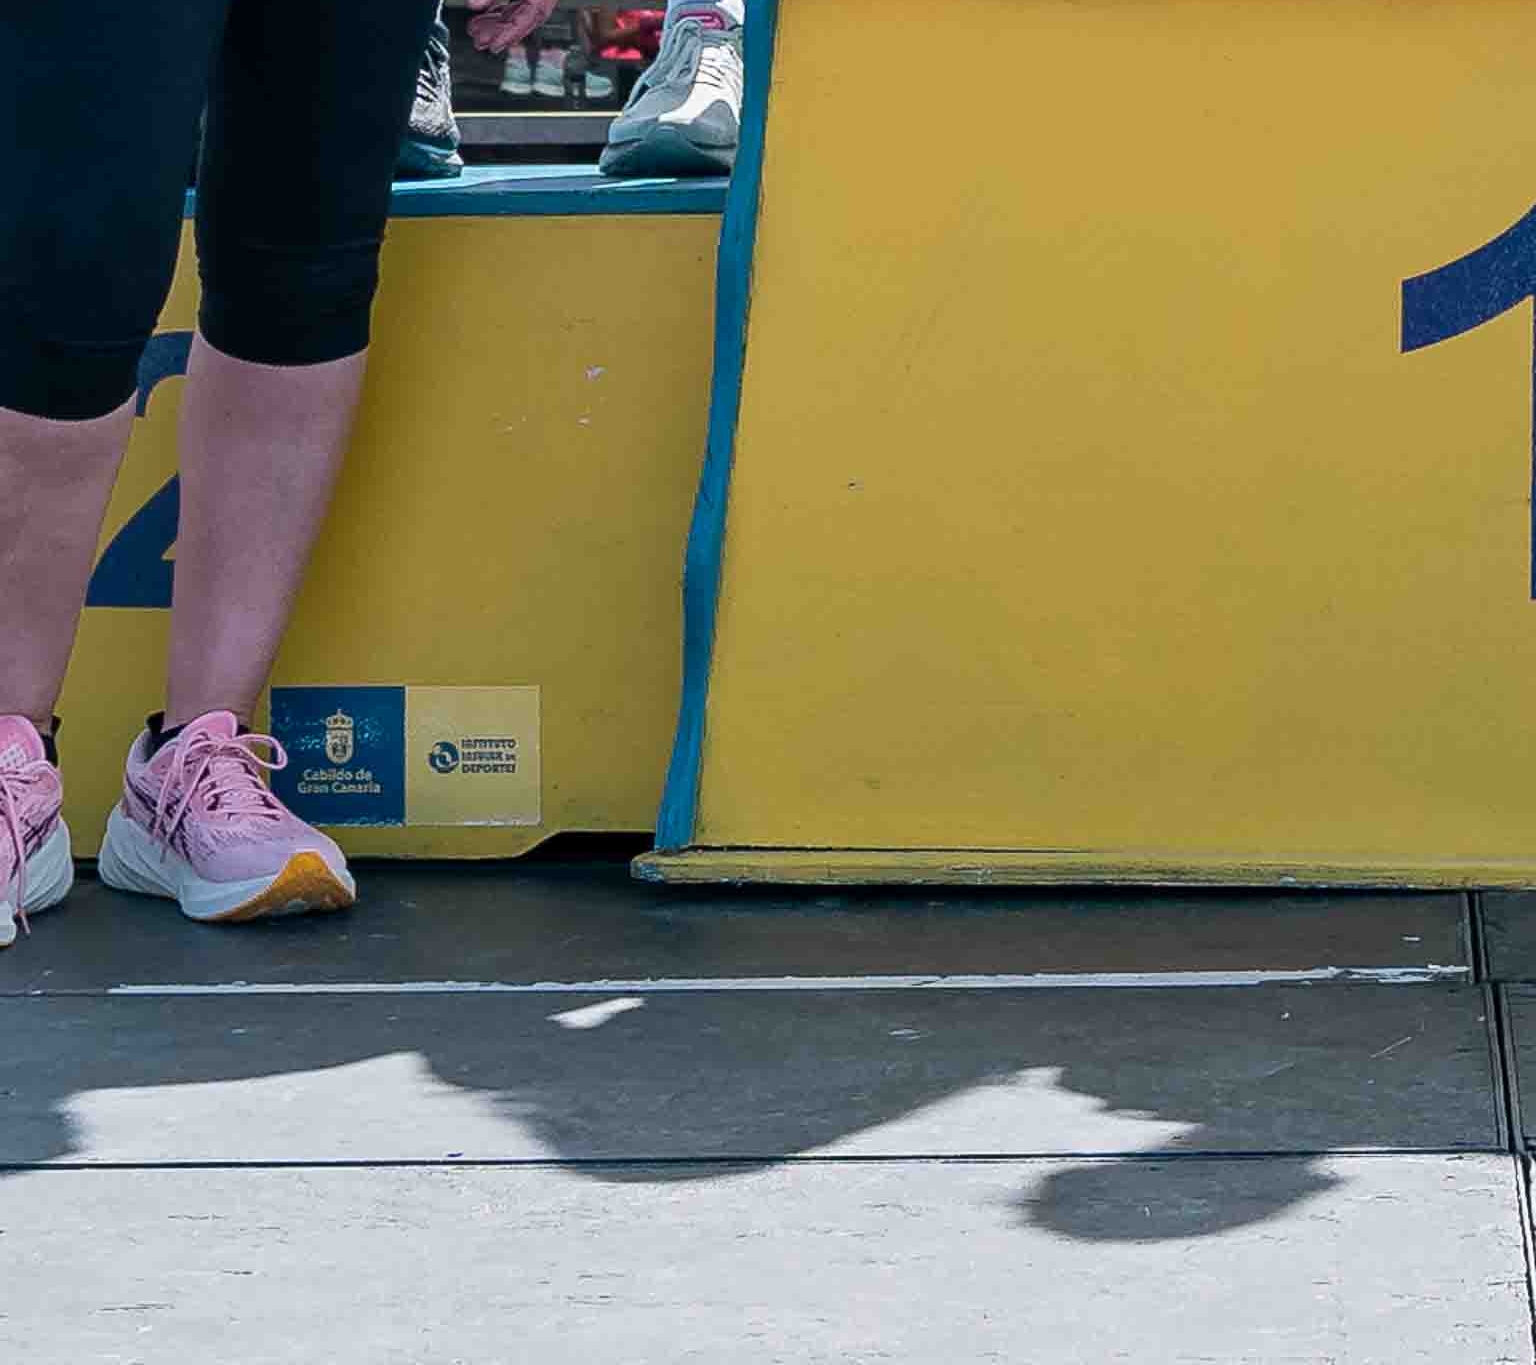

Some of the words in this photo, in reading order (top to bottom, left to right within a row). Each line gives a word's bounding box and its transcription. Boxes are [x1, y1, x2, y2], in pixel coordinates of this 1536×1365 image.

[303, 768, 352, 781] Cabildo
[355, 768, 372, 781] de
[298, 782, 330, 794] Gran
[331, 781, 382, 795] Canaria
